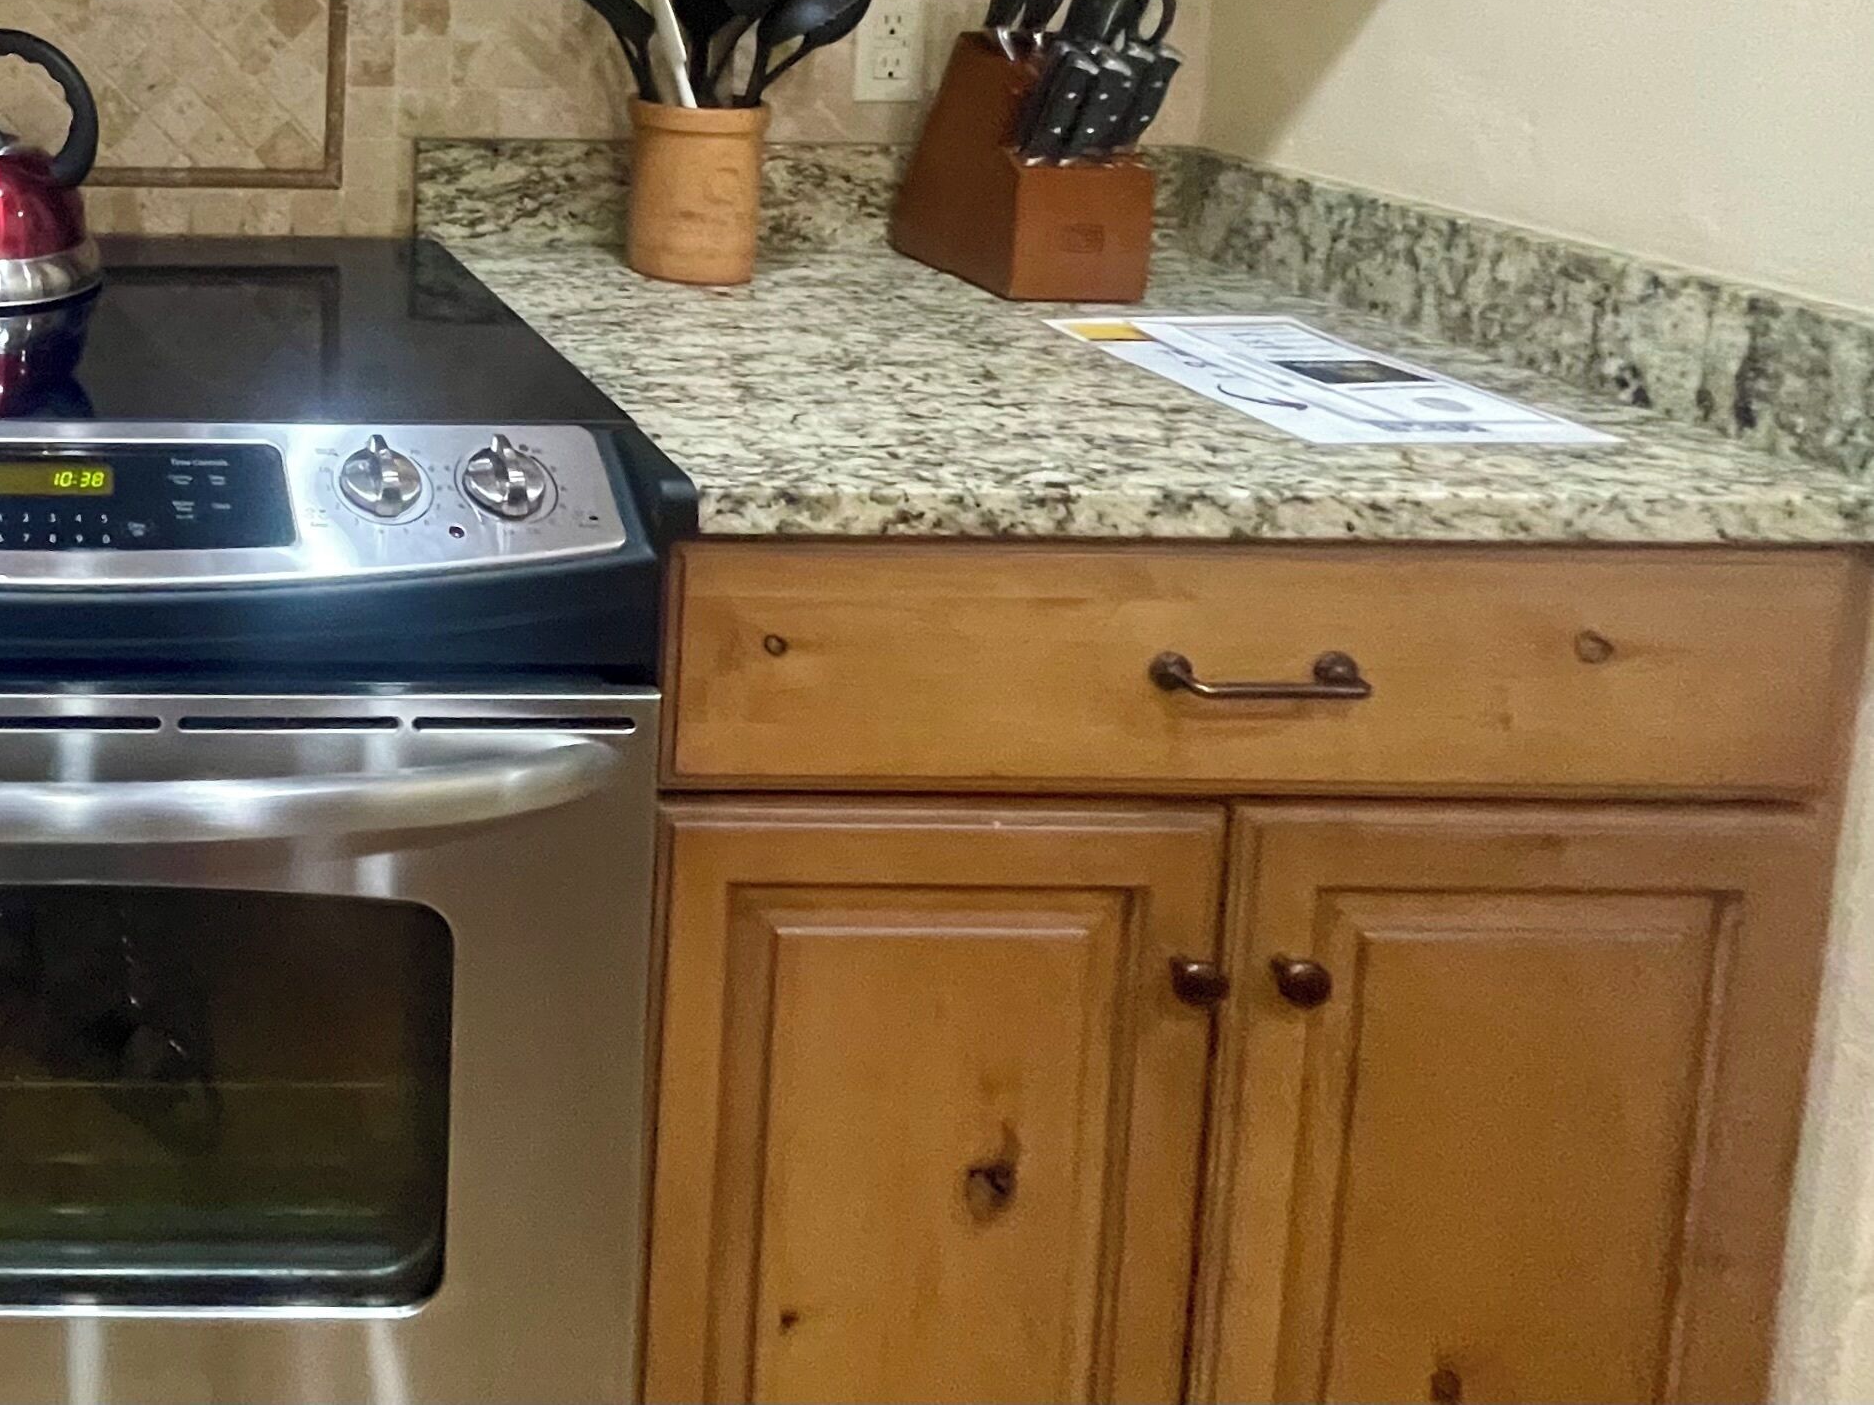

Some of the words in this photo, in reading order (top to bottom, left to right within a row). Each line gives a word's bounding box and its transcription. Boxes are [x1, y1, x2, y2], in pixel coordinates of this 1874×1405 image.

[22, 513, 29, 523] 2
[49, 513, 56, 523] 3
[75, 513, 82, 523] 4
[100, 513, 108, 524] 5
[23, 532, 30, 542] 7
[49, 533, 57, 544] 8
[76, 533, 83, 543] 9
[102, 533, 111, 544] 0
